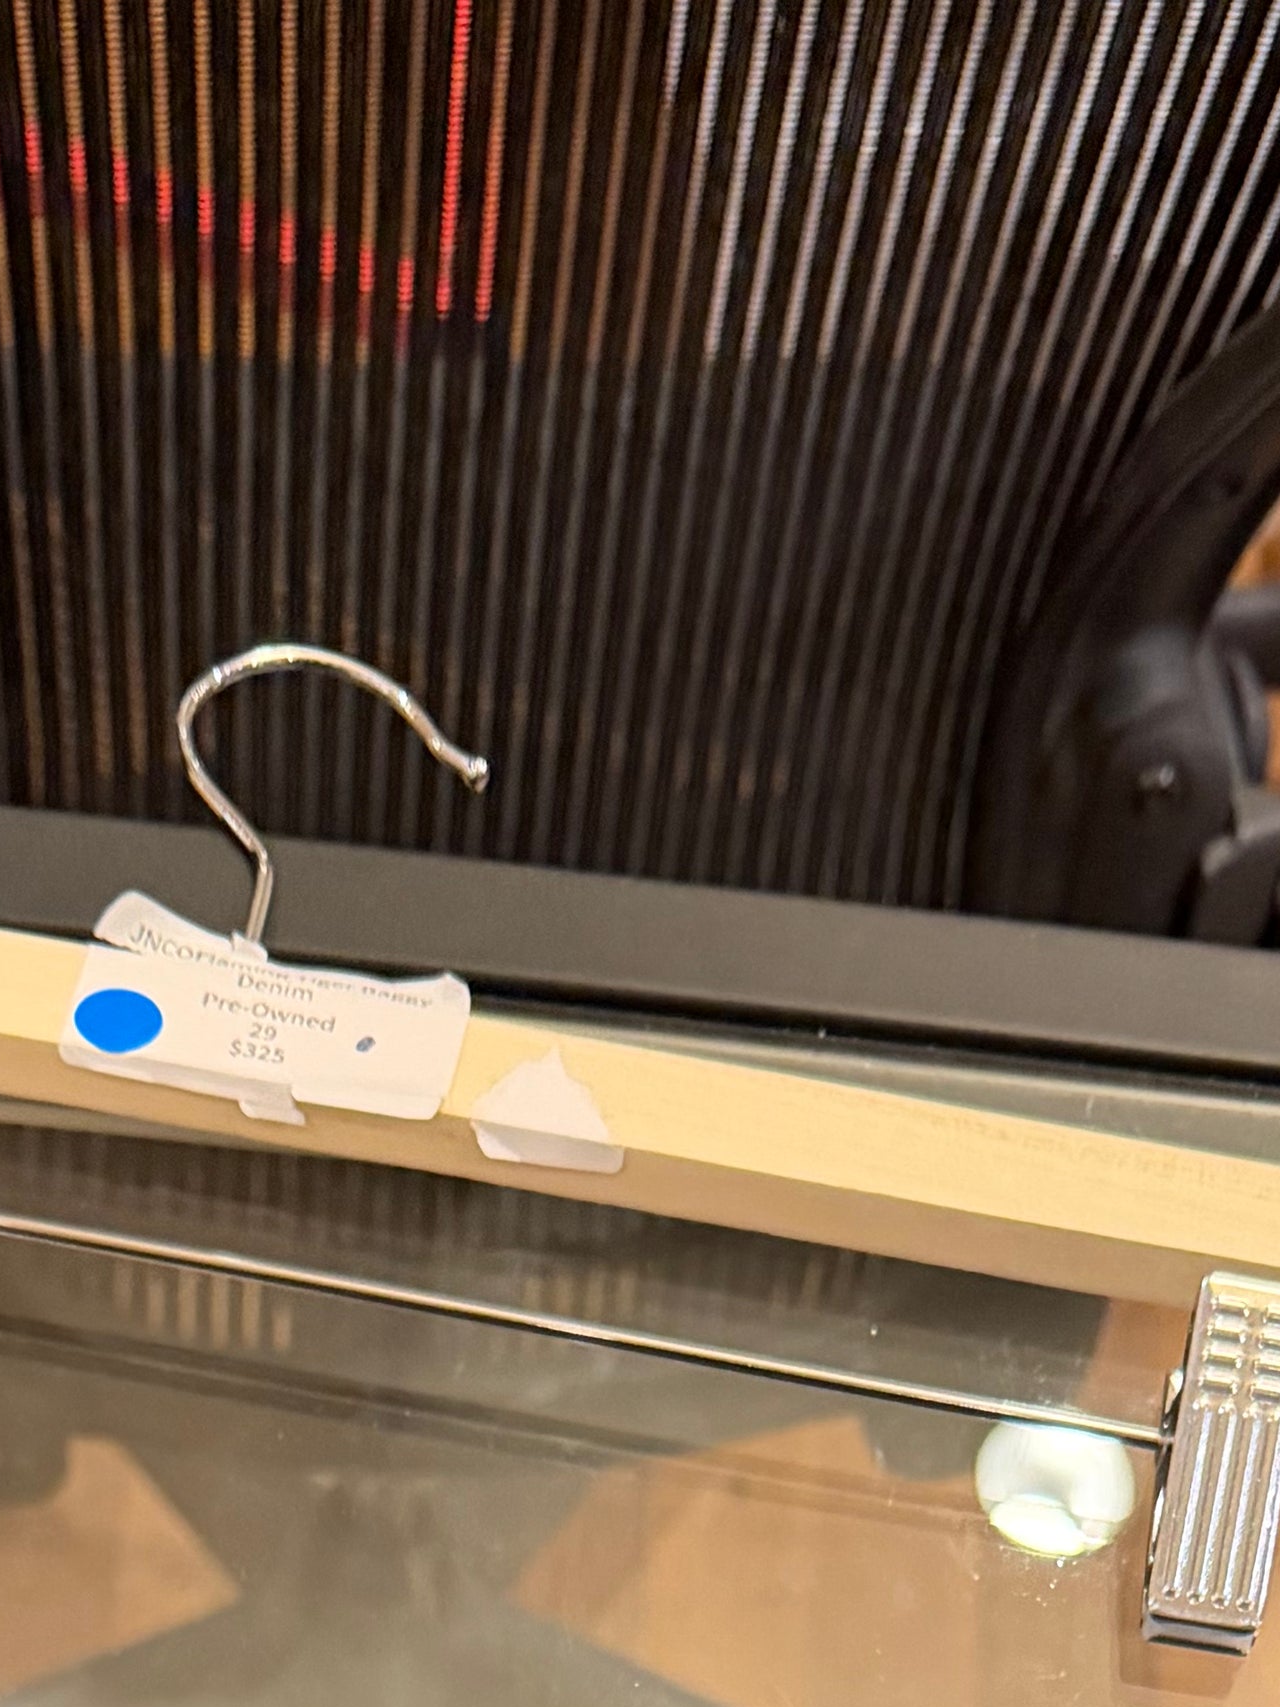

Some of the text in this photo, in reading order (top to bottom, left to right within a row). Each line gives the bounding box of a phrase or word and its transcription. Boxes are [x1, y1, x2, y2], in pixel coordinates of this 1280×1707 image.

[237, 973, 314, 1002] Denim
[202, 991, 336, 1034] Pre-Owned
[249, 1022, 277, 1042] 29
[229, 1039, 285, 1065] $325
